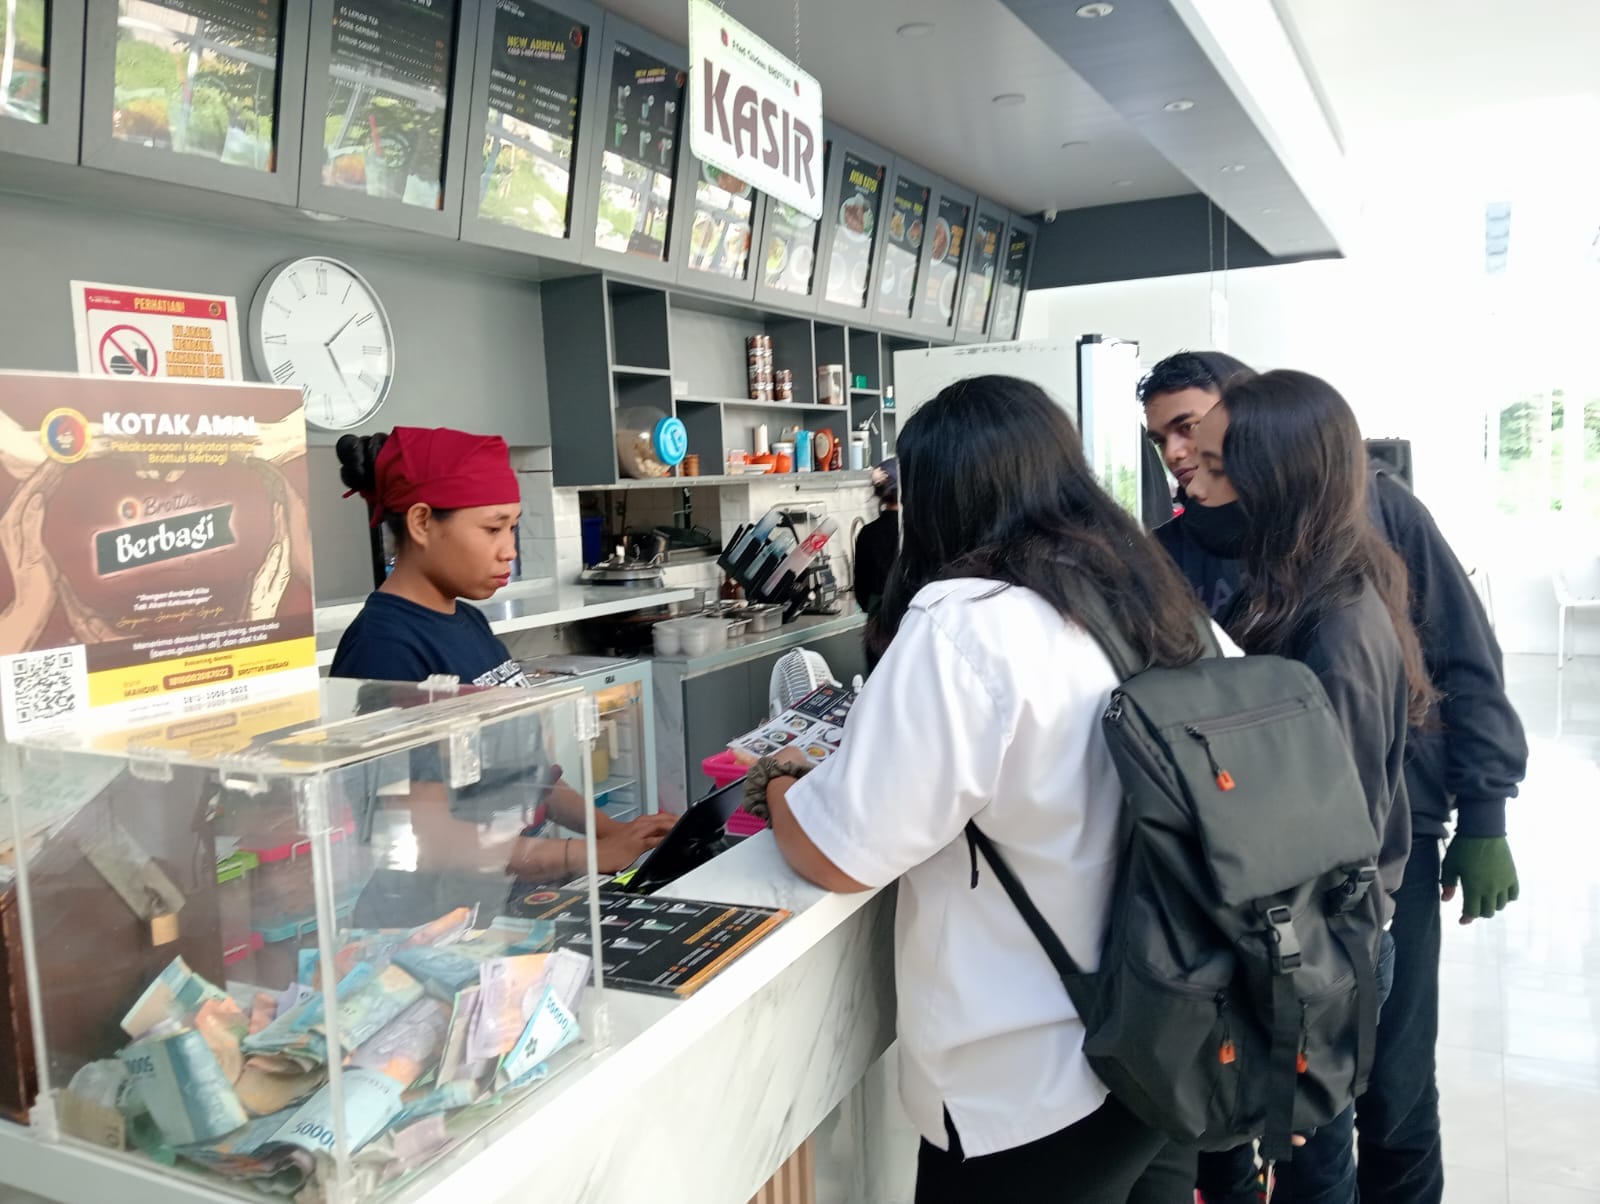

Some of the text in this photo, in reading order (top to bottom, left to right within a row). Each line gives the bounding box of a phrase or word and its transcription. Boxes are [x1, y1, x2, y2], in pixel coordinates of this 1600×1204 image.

[507, 35, 566, 53] NEW ARRIVAL
[704, 57, 815, 199] KASIR
[102, 412, 191, 436] KOTAK
[188, 452, 228, 465] Berbagi
[115, 513, 214, 563] Berbagi
